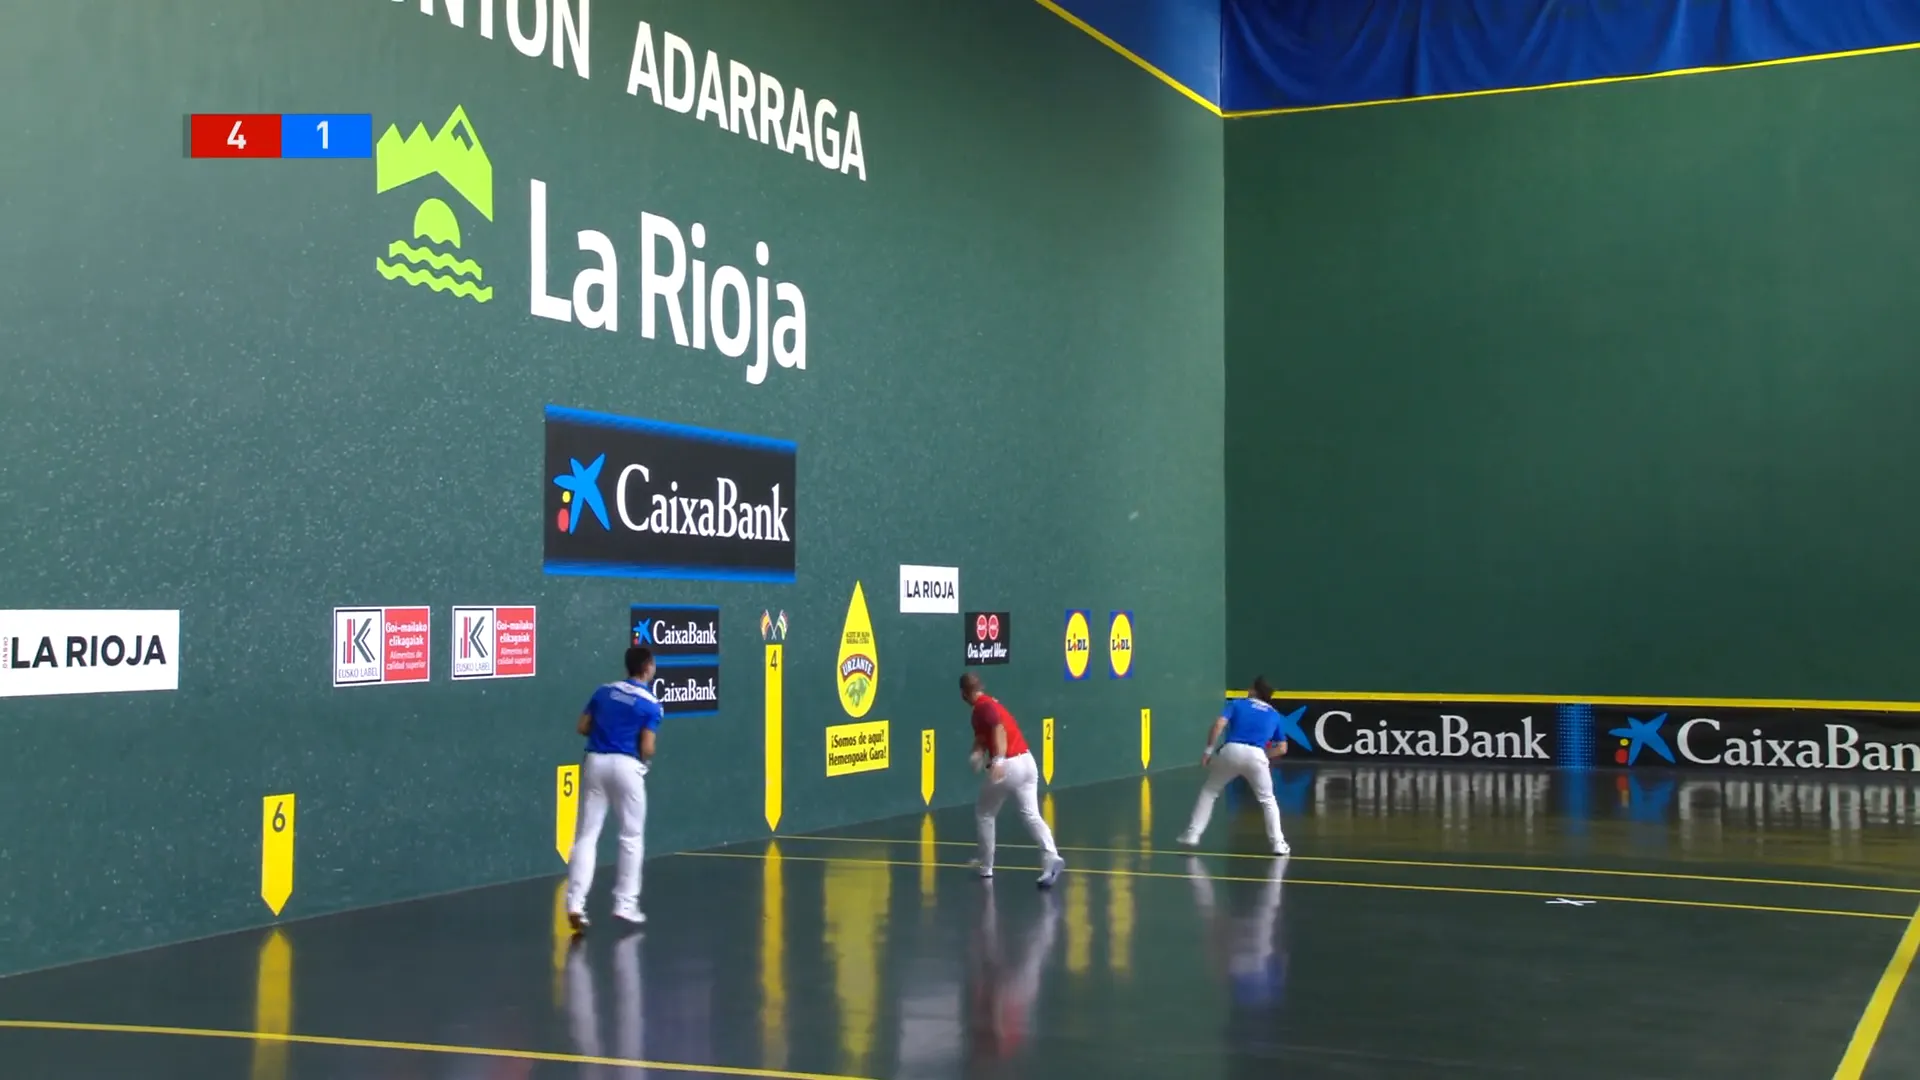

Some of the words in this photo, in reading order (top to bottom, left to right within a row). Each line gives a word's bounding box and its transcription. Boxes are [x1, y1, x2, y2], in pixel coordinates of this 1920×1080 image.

[626, 21, 867, 181] ADARRAGA
[530, 178, 618, 332] La
[641, 211, 806, 385] Rioja
[616, 463, 790, 542] CaixaBank
[906, 580, 921, 598] LA
[923, 580, 955, 600] RIOJA
[652, 618, 717, 645] CaixaBank
[11, 636, 59, 669] LA
[66, 634, 167, 668] RIOJA
[769, 649, 778, 671] 4
[360, 667, 378, 678] LABEL
[842, 656, 873, 676] URZANTE
[652, 678, 717, 703] CaixaBank
[858, 731, 867, 745] de
[925, 734, 931, 753] 3
[1045, 723, 1051, 740] 2
[1314, 710, 1550, 761] CaixaBank
[869, 745, 887, 760] Gara!
[563, 771, 573, 797] 5
[271, 801, 286, 834] 6
